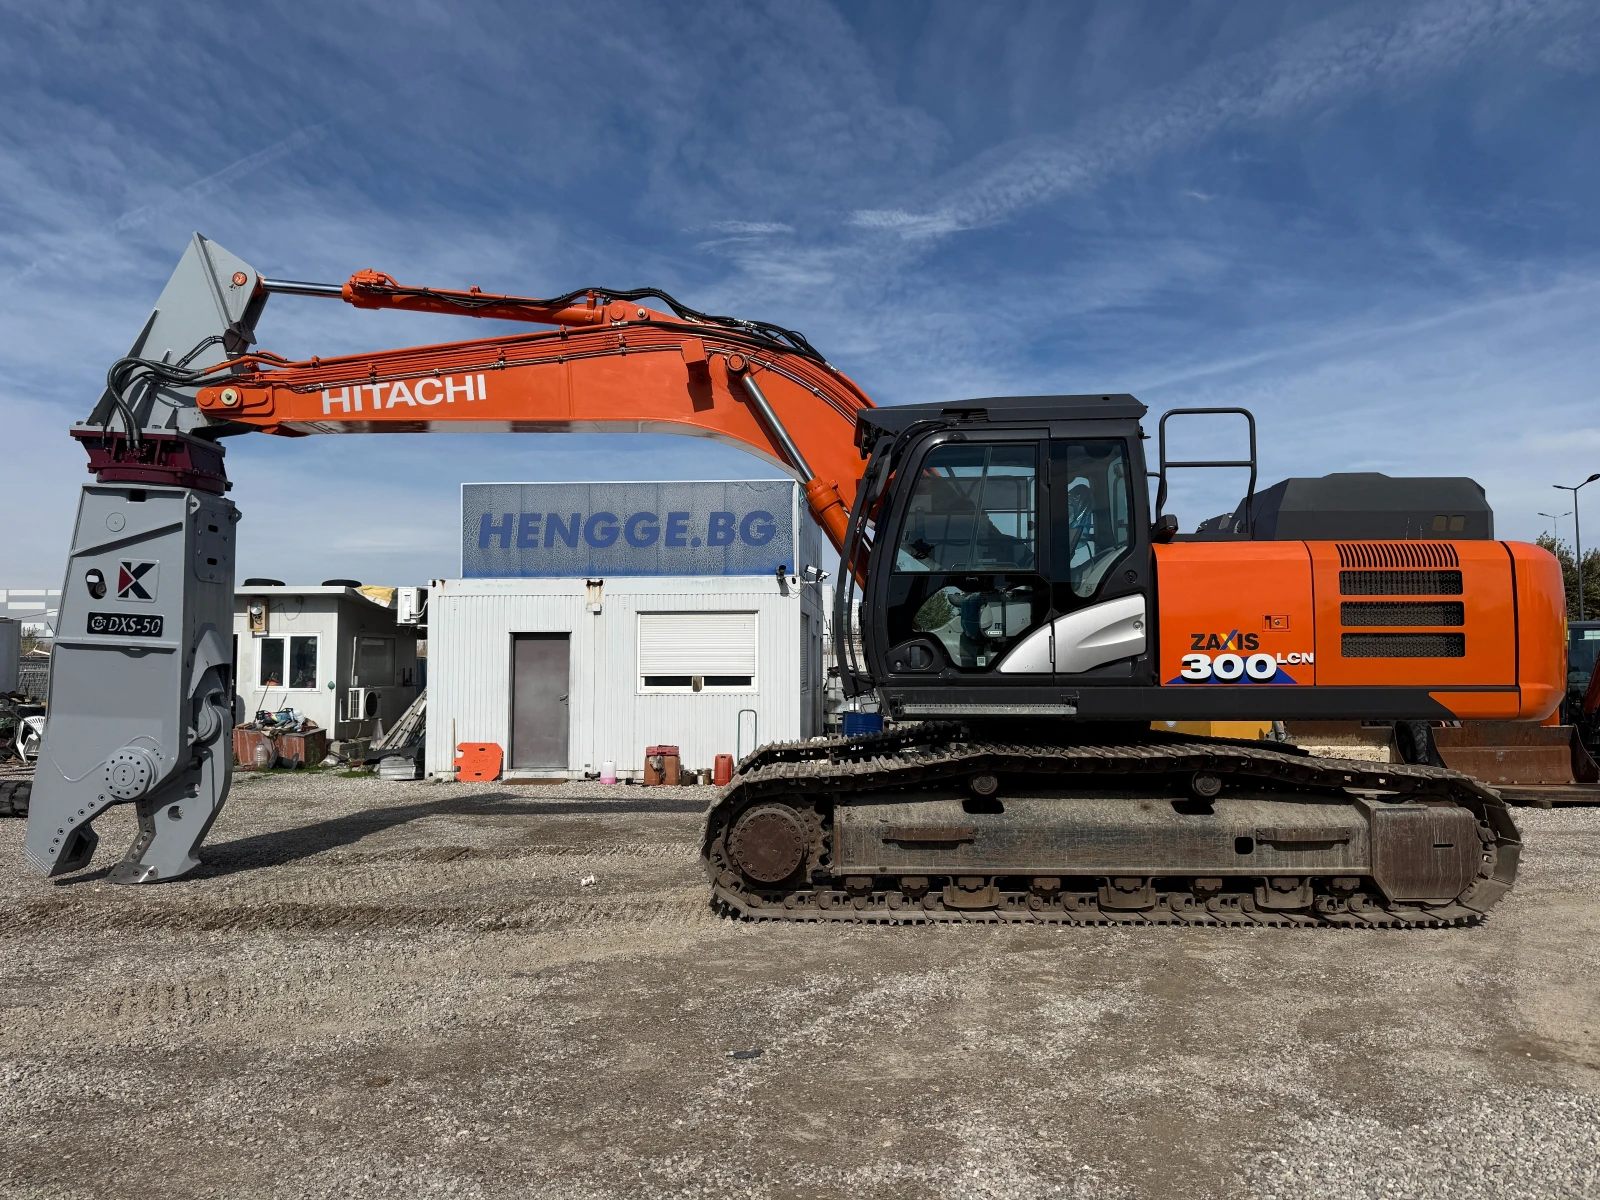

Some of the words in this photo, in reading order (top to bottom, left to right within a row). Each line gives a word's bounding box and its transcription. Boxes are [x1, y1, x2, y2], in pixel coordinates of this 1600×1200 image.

[321, 374, 488, 415] HITACHI
[477, 510, 777, 549] HENGGE.BG
[107, 616, 161, 634] DXS-50
[1190, 629, 1260, 651] ZAXIS
